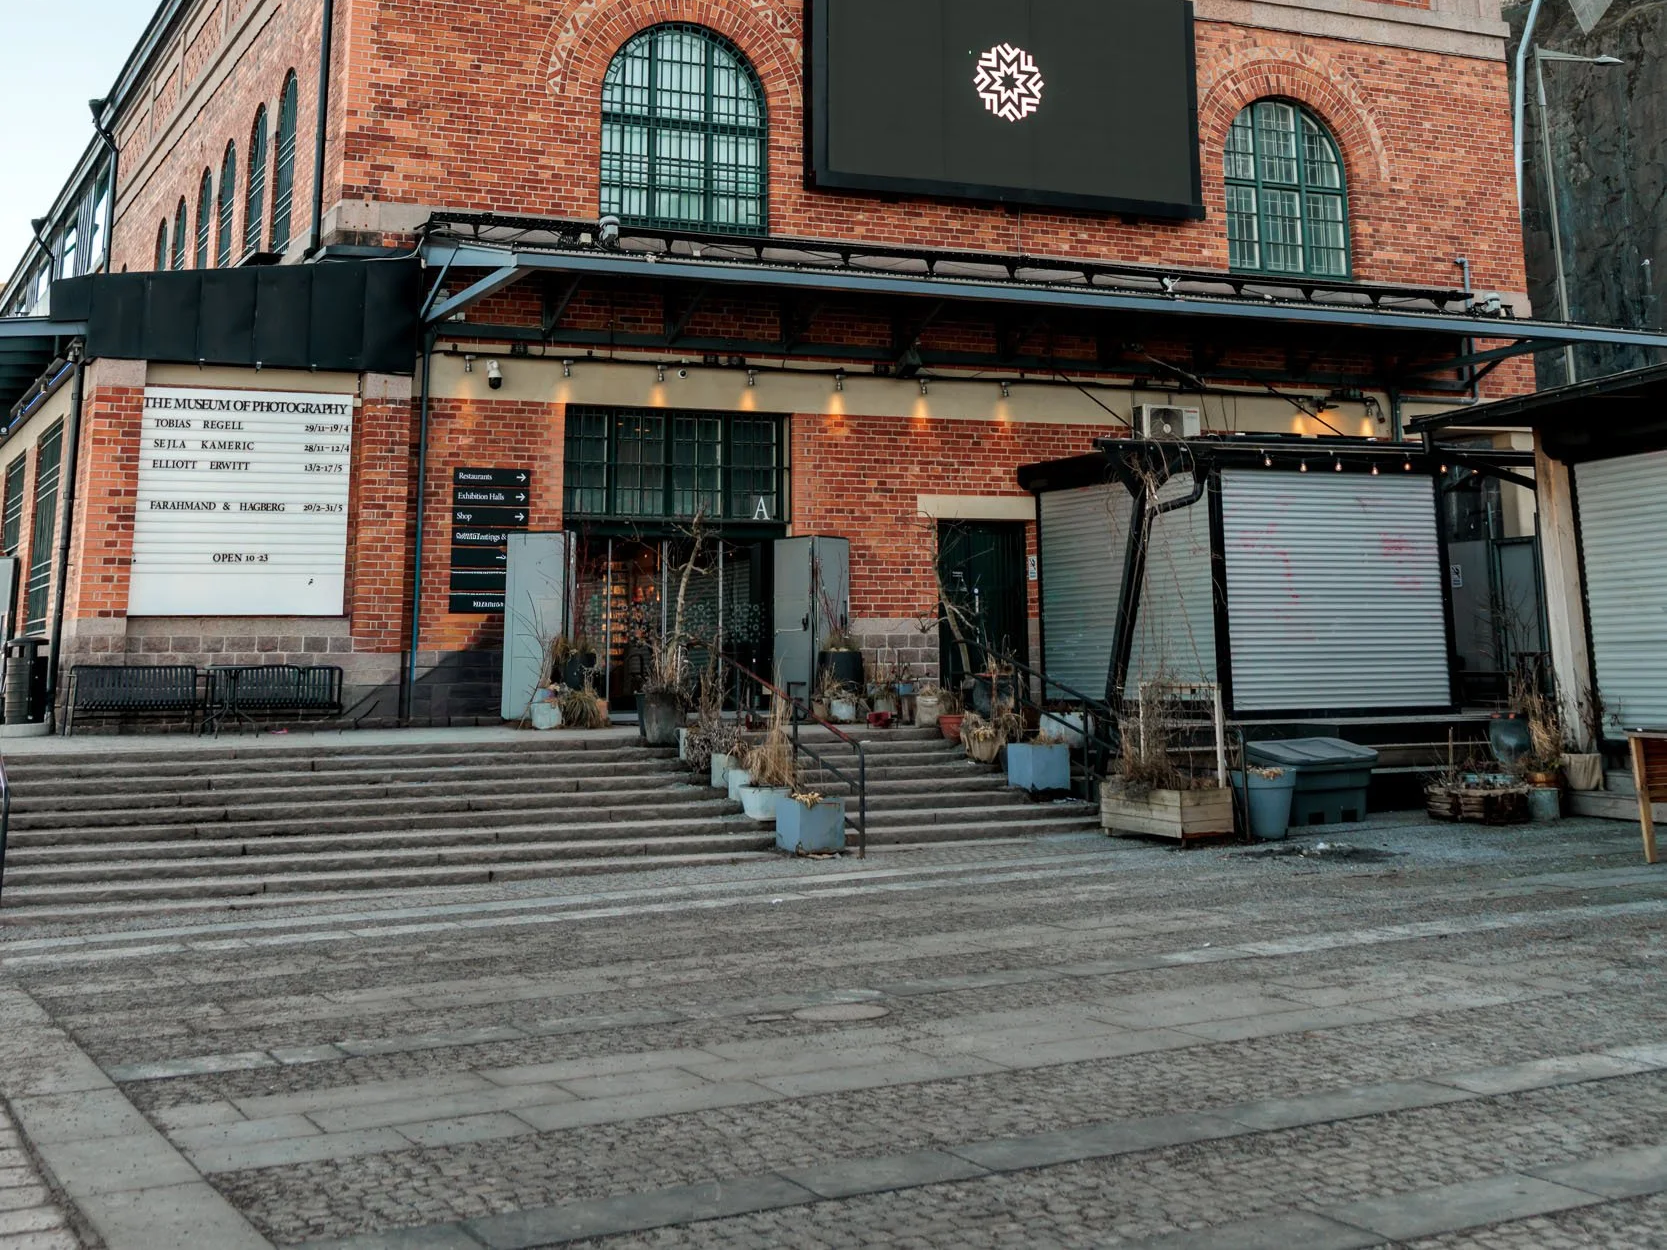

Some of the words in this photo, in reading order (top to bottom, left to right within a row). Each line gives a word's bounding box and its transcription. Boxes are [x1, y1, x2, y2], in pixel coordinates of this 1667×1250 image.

[144, 397, 172, 408] THE
[174, 398, 230, 410] MUSEUM
[233, 400, 250, 411] OF
[253, 401, 348, 415] PHOTOGRAPHY
[155, 419, 191, 429] TOBIAS
[203, 420, 244, 430] REGELL
[153, 439, 186, 449] SEJLA
[201, 440, 255, 450] KAMERIC
[152, 459, 198, 469] ELLIOTT
[209, 461, 250, 470] ERWITT
[458, 472, 493, 480] Restaurants
[457, 492, 488, 500] Exhibition
[150, 501, 216, 510] FARAHMAND
[222, 502, 231, 510] &
[239, 502, 285, 511] HAGBERG
[752, 495, 770, 520] A
[456, 512, 473, 521] Shop
[212, 553, 242, 562] OPEN
